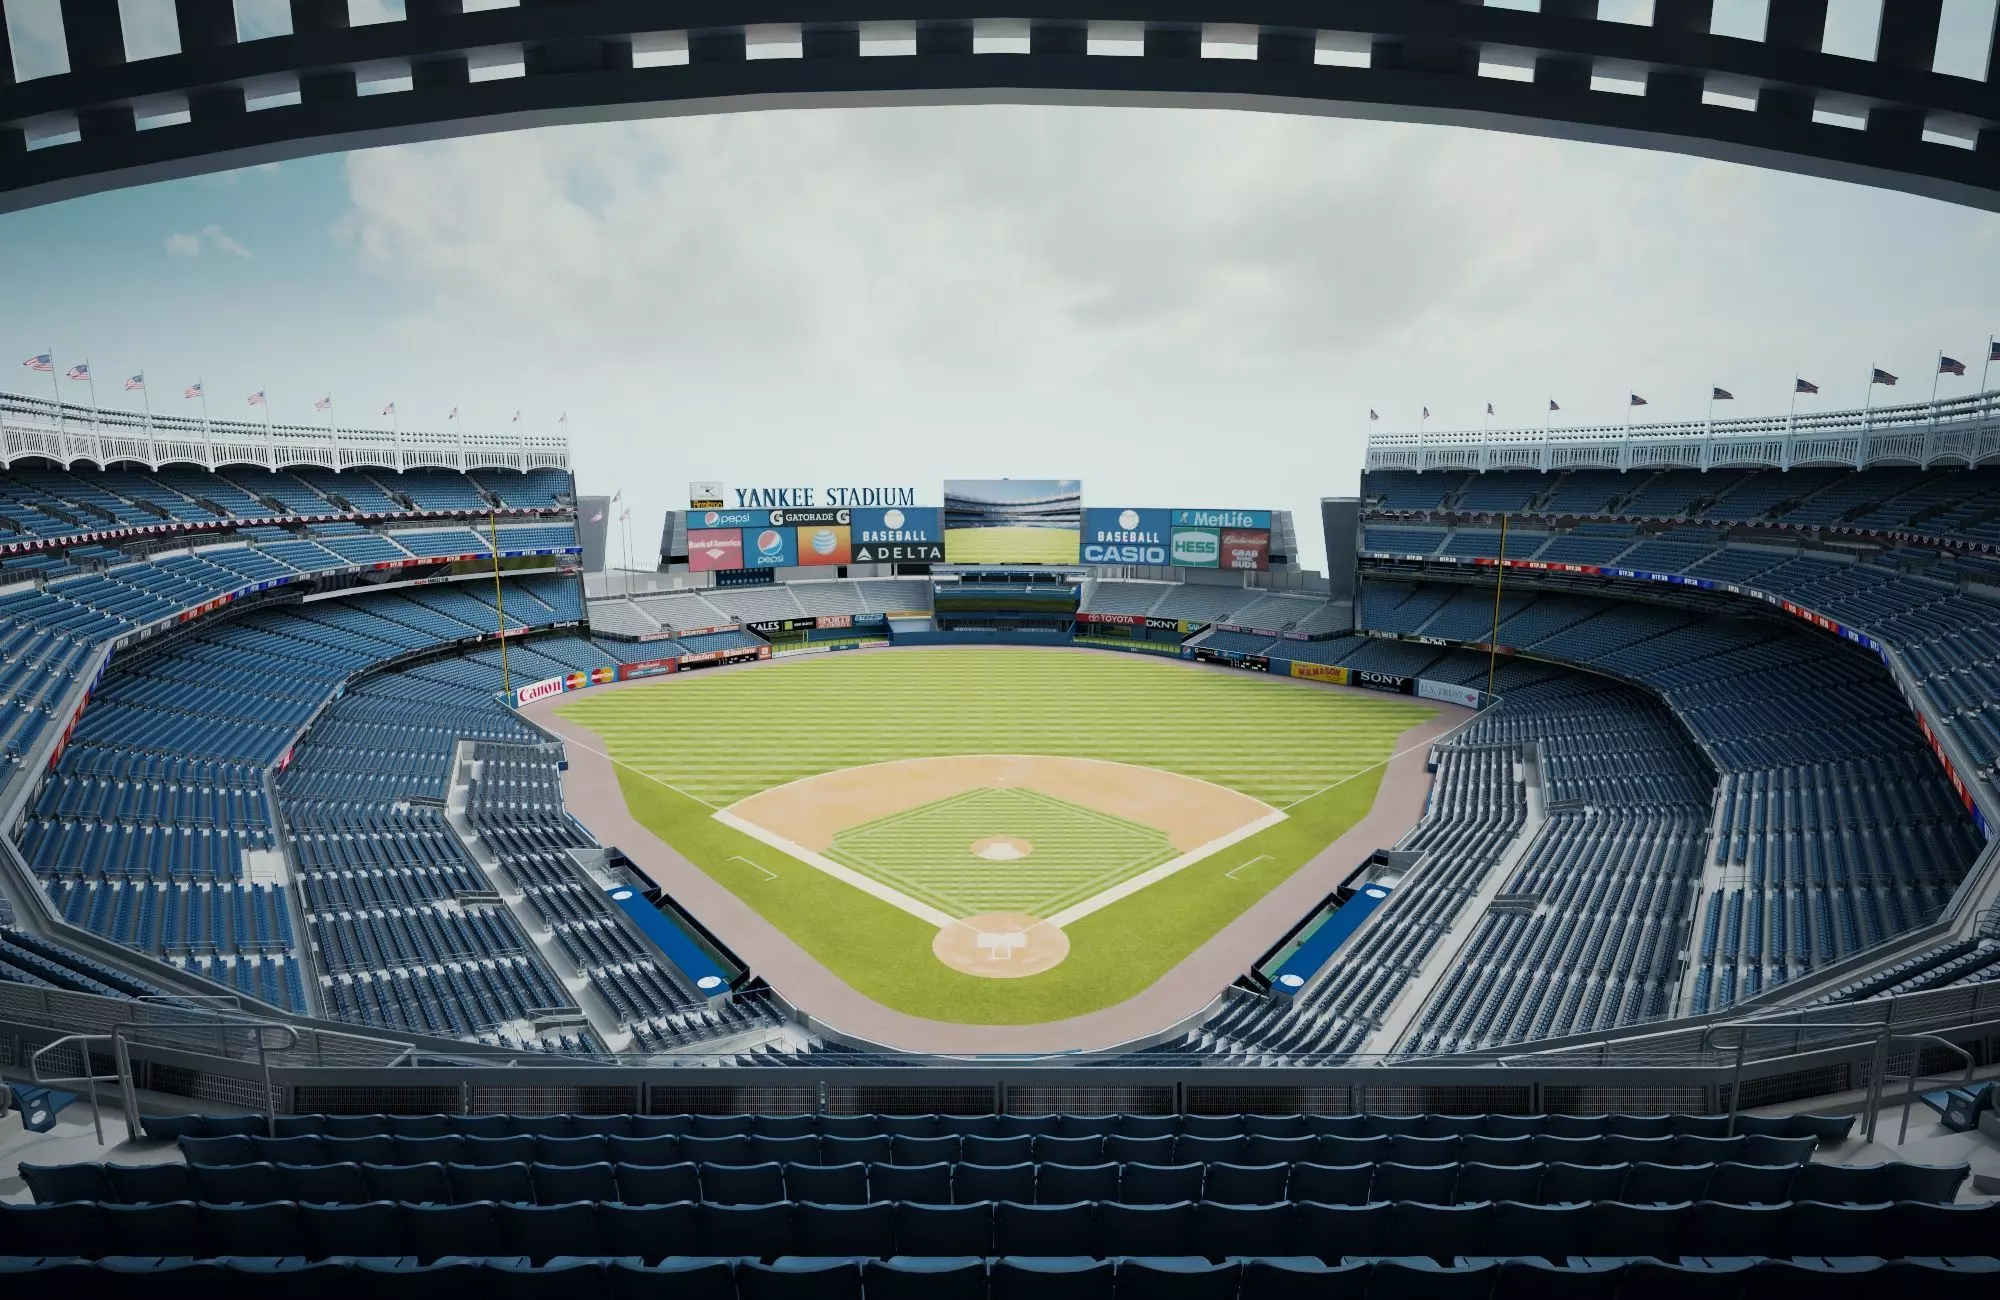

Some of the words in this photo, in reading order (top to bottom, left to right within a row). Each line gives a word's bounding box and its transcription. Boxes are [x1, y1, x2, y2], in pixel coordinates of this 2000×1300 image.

[735, 488, 815, 507] YANKEE
[826, 487, 915, 506] STADIUM
[693, 500, 722, 509] Armitron
[720, 513, 750, 525] pepsi
[785, 513, 834, 521] GATORADE
[1193, 511, 1253, 528] MetLife
[862, 530, 927, 542] BASEBALL
[1097, 531, 1160, 543] BASEBALL
[689, 540, 707, 549] Bank
[707, 540, 714, 548] of
[714, 539, 741, 547] America
[1174, 541, 1216, 554] HESS
[878, 546, 942, 559] DELTA
[1084, 545, 1165, 563] CASIO
[757, 555, 784, 565] pepsi
[1231, 561, 1257, 569] BUDS
[817, 615, 851, 624] SPORTS
[1100, 614, 1134, 624] TOYOTA
[1146, 619, 1178, 630] DKNY
[1360, 671, 1405, 686] SONY
[519, 681, 561, 702] Canon
